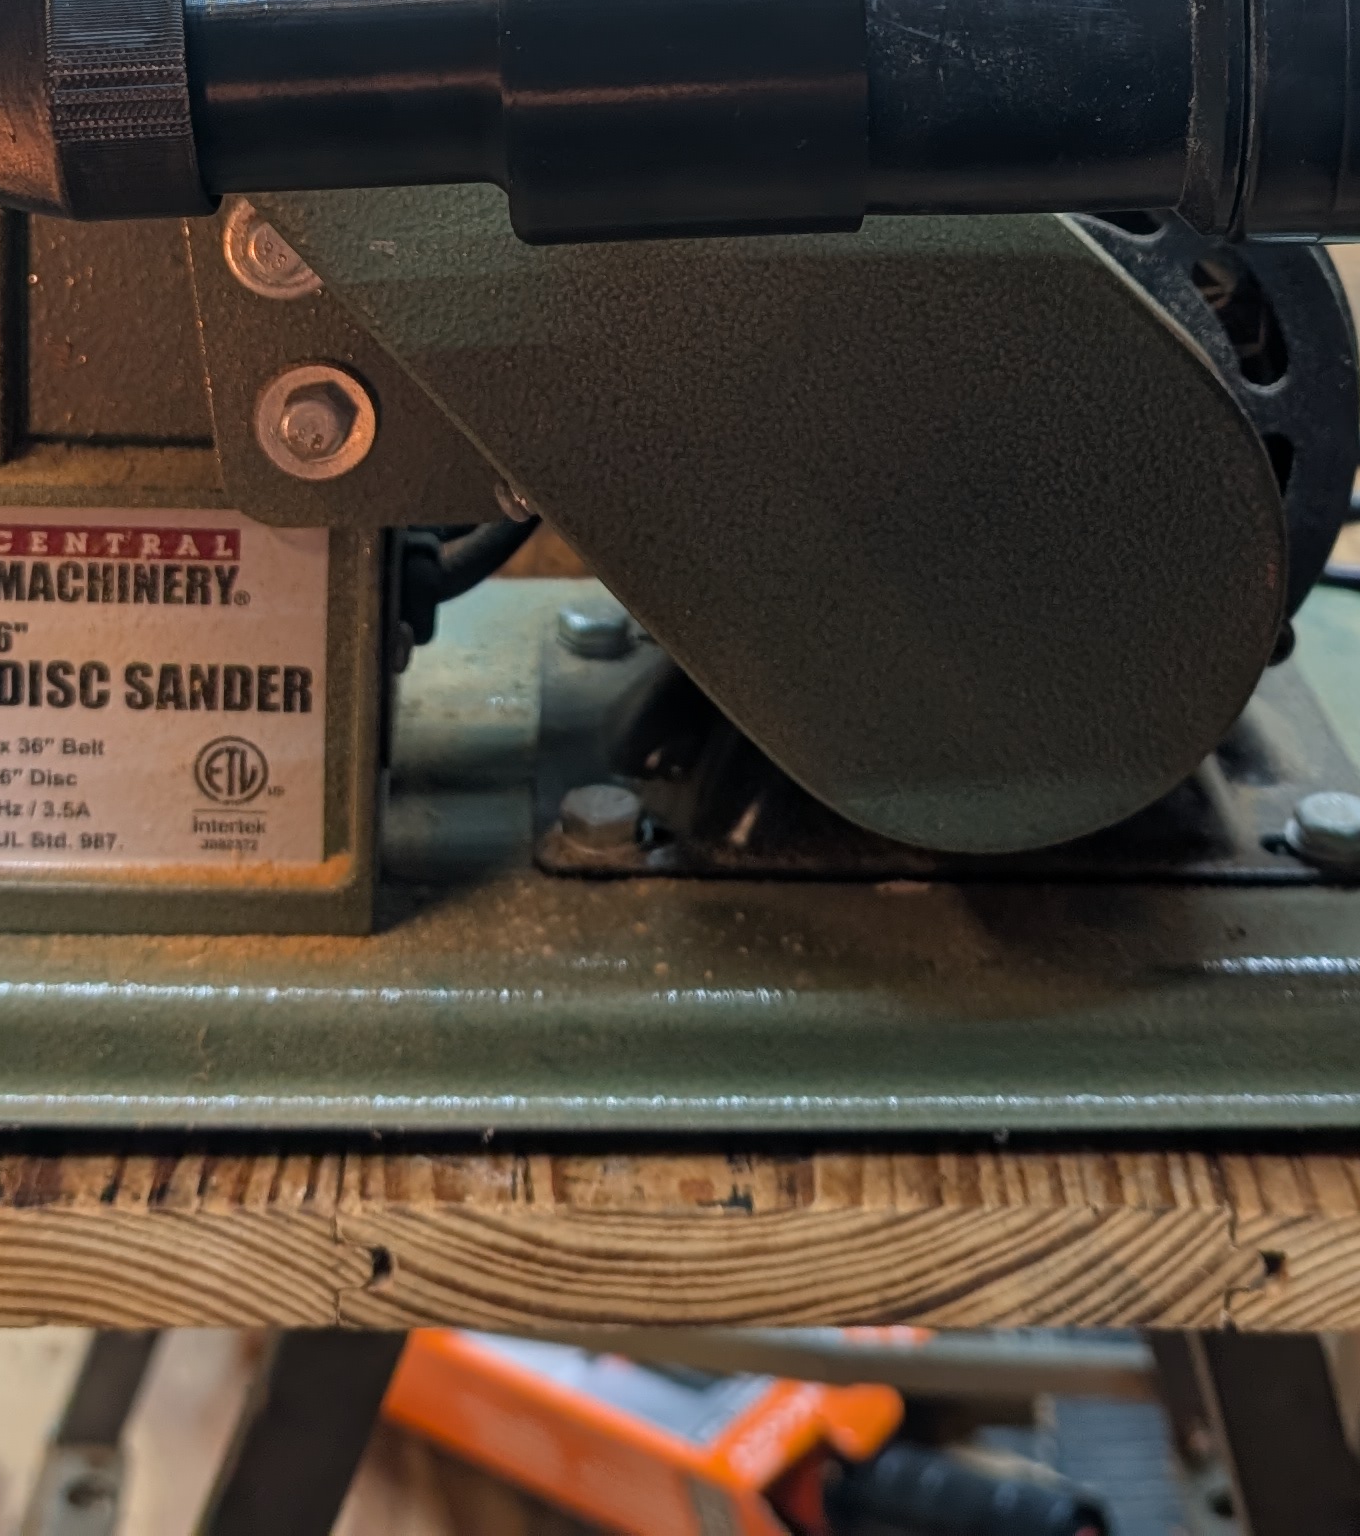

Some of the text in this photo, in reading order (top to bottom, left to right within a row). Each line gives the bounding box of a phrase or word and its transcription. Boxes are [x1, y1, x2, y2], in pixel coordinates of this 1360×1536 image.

[124, 661, 314, 714] SANDER
[61, 737, 106, 757] Belt
[29, 768, 79, 787] Disc
